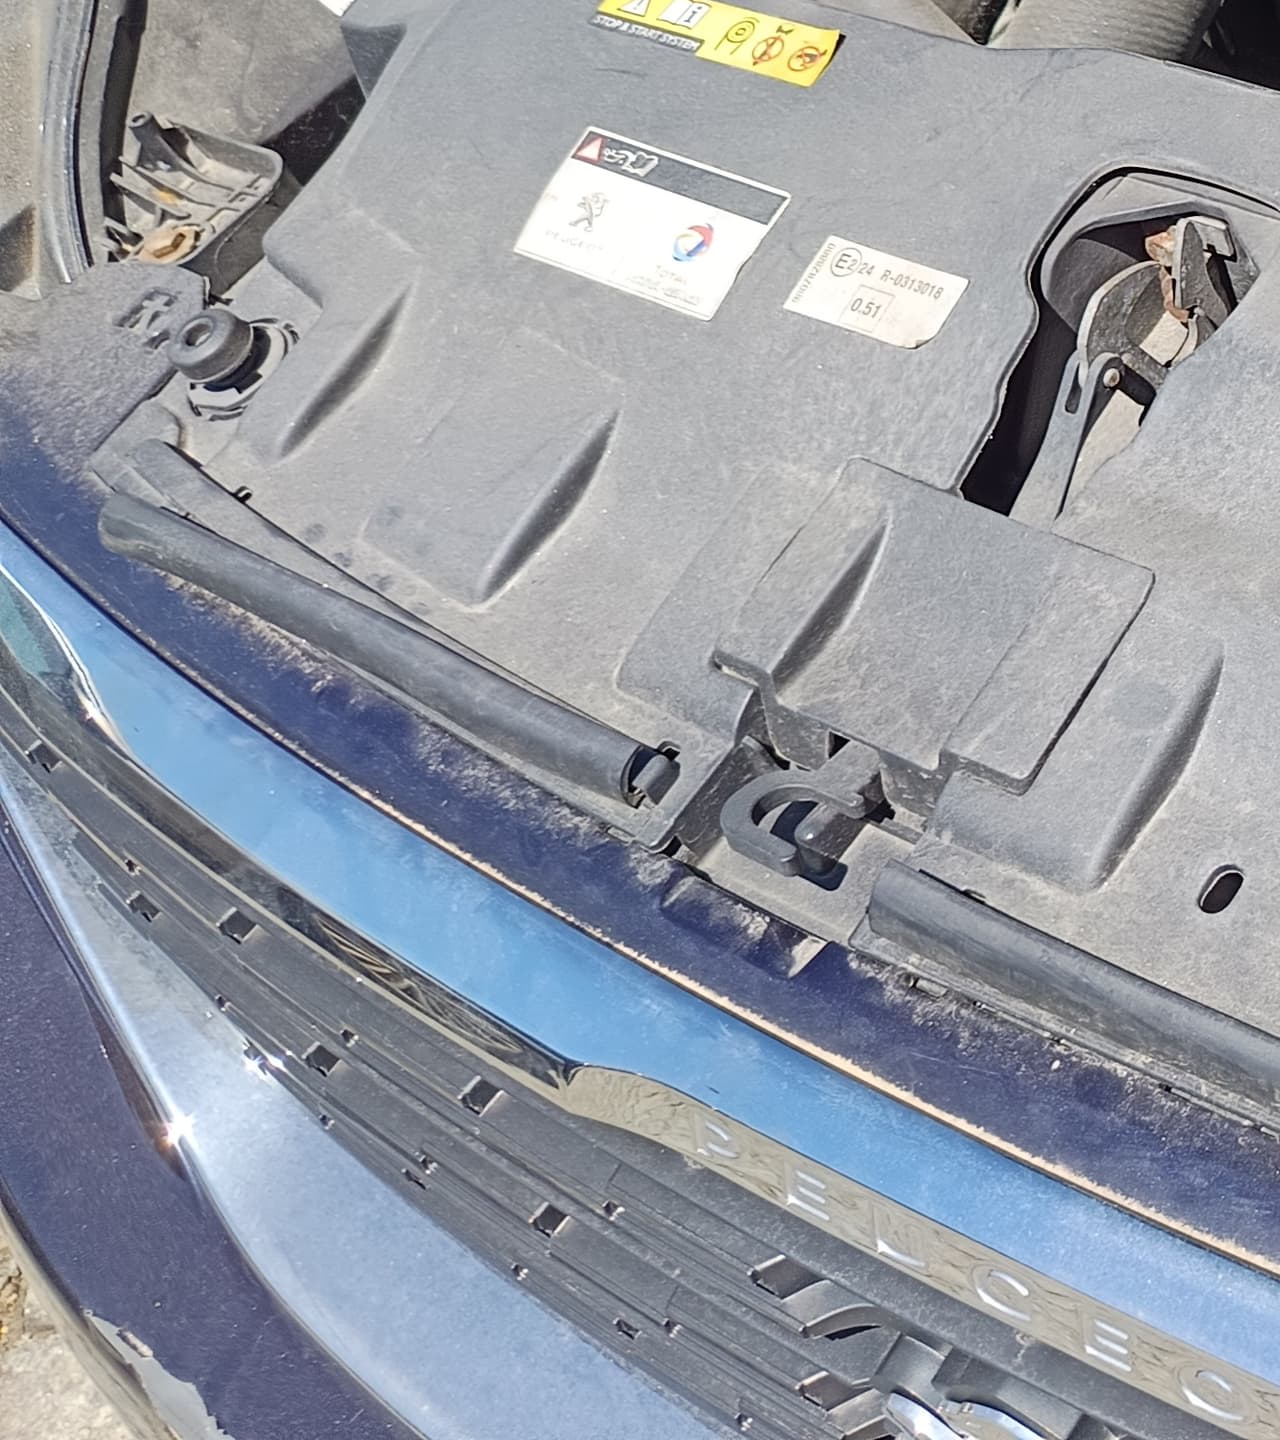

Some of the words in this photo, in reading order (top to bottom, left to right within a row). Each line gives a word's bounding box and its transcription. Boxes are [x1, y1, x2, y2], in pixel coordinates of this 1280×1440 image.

[593, 14, 623, 30] STOP
[630, 24, 662, 40] START
[659, 33, 701, 50] SYSTEM
[880, 269, 944, 300] R-0313018
[850, 297, 882, 318] 0.51
